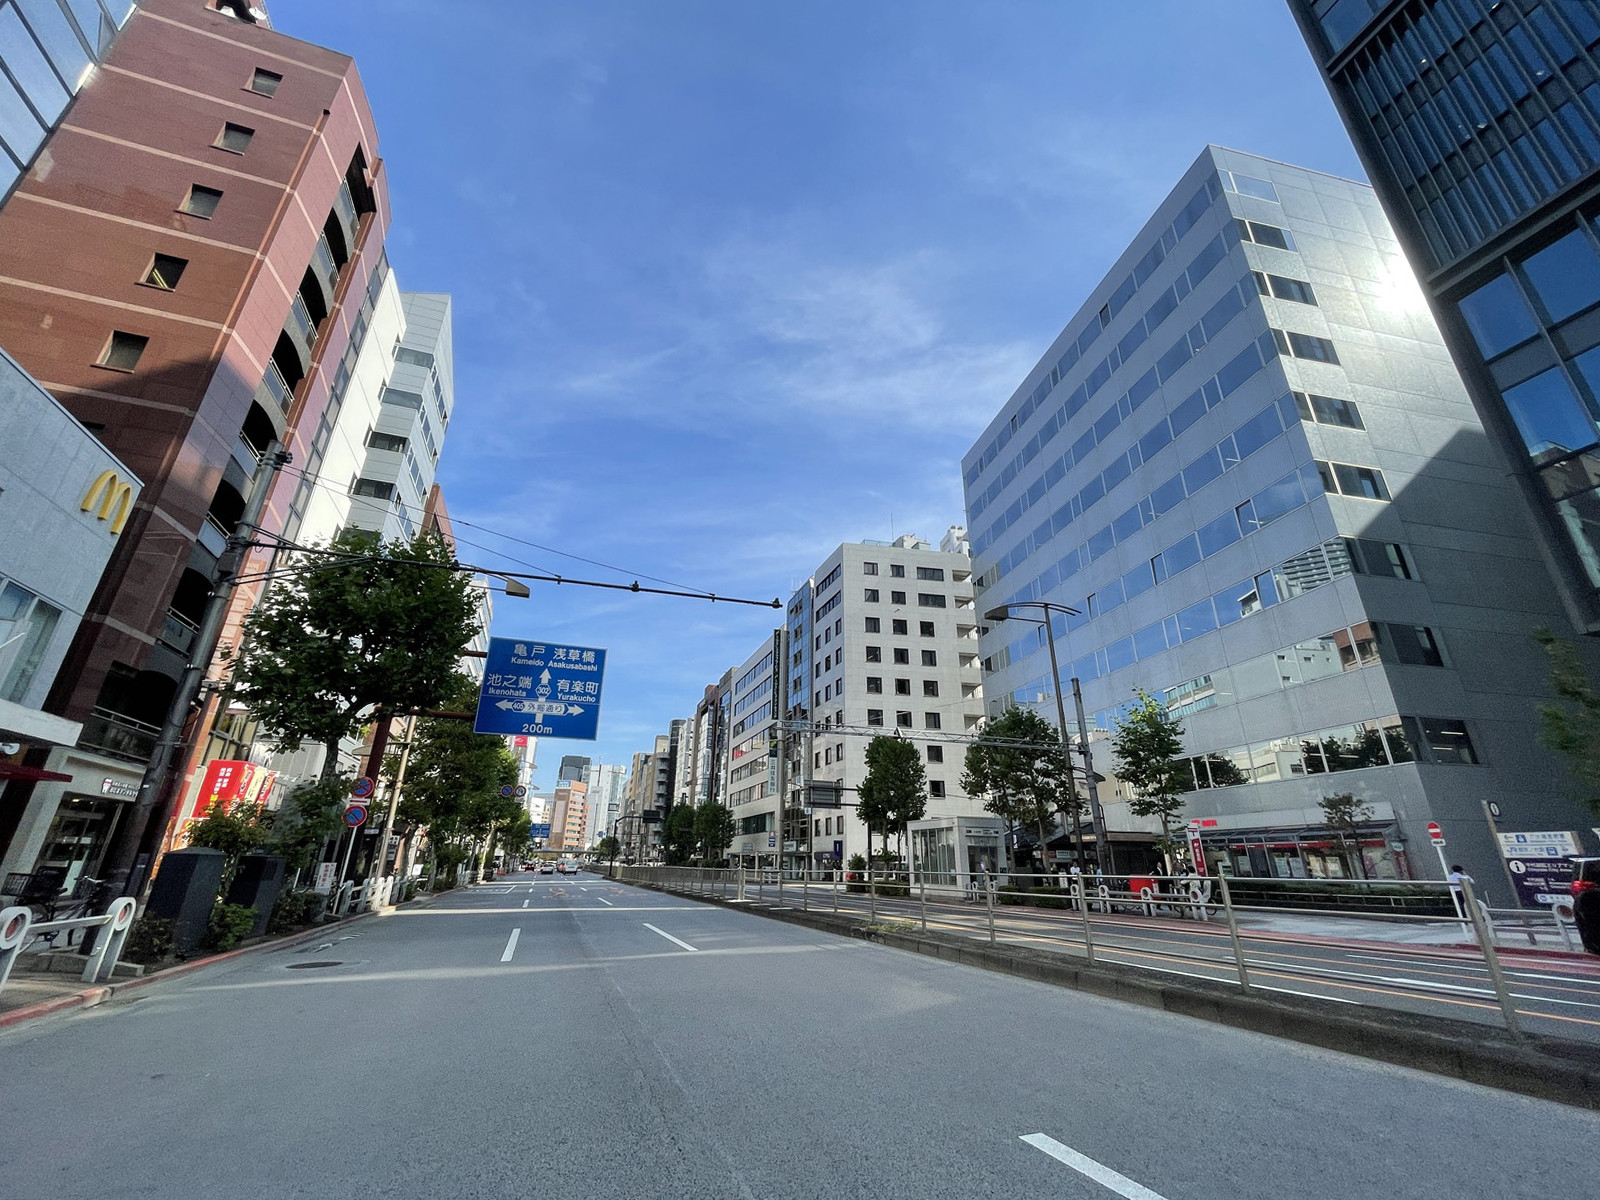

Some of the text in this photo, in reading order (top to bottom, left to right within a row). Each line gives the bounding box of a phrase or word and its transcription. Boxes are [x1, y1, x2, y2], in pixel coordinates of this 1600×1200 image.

[514, 644, 595, 663] 亀戸 浅草橋
[511, 656, 597, 672] Kameido Asakusabashi
[487, 674, 532, 689] 池之端
[557, 679, 599, 694] 有楽町
[488, 687, 526, 697] Ikenohata
[537, 686, 550, 695] 302
[557, 693, 595, 703] Yurakucho
[513, 701, 524, 710] 405
[527, 702, 563, 713] 外堀通り
[522, 724, 552, 734] 200m
